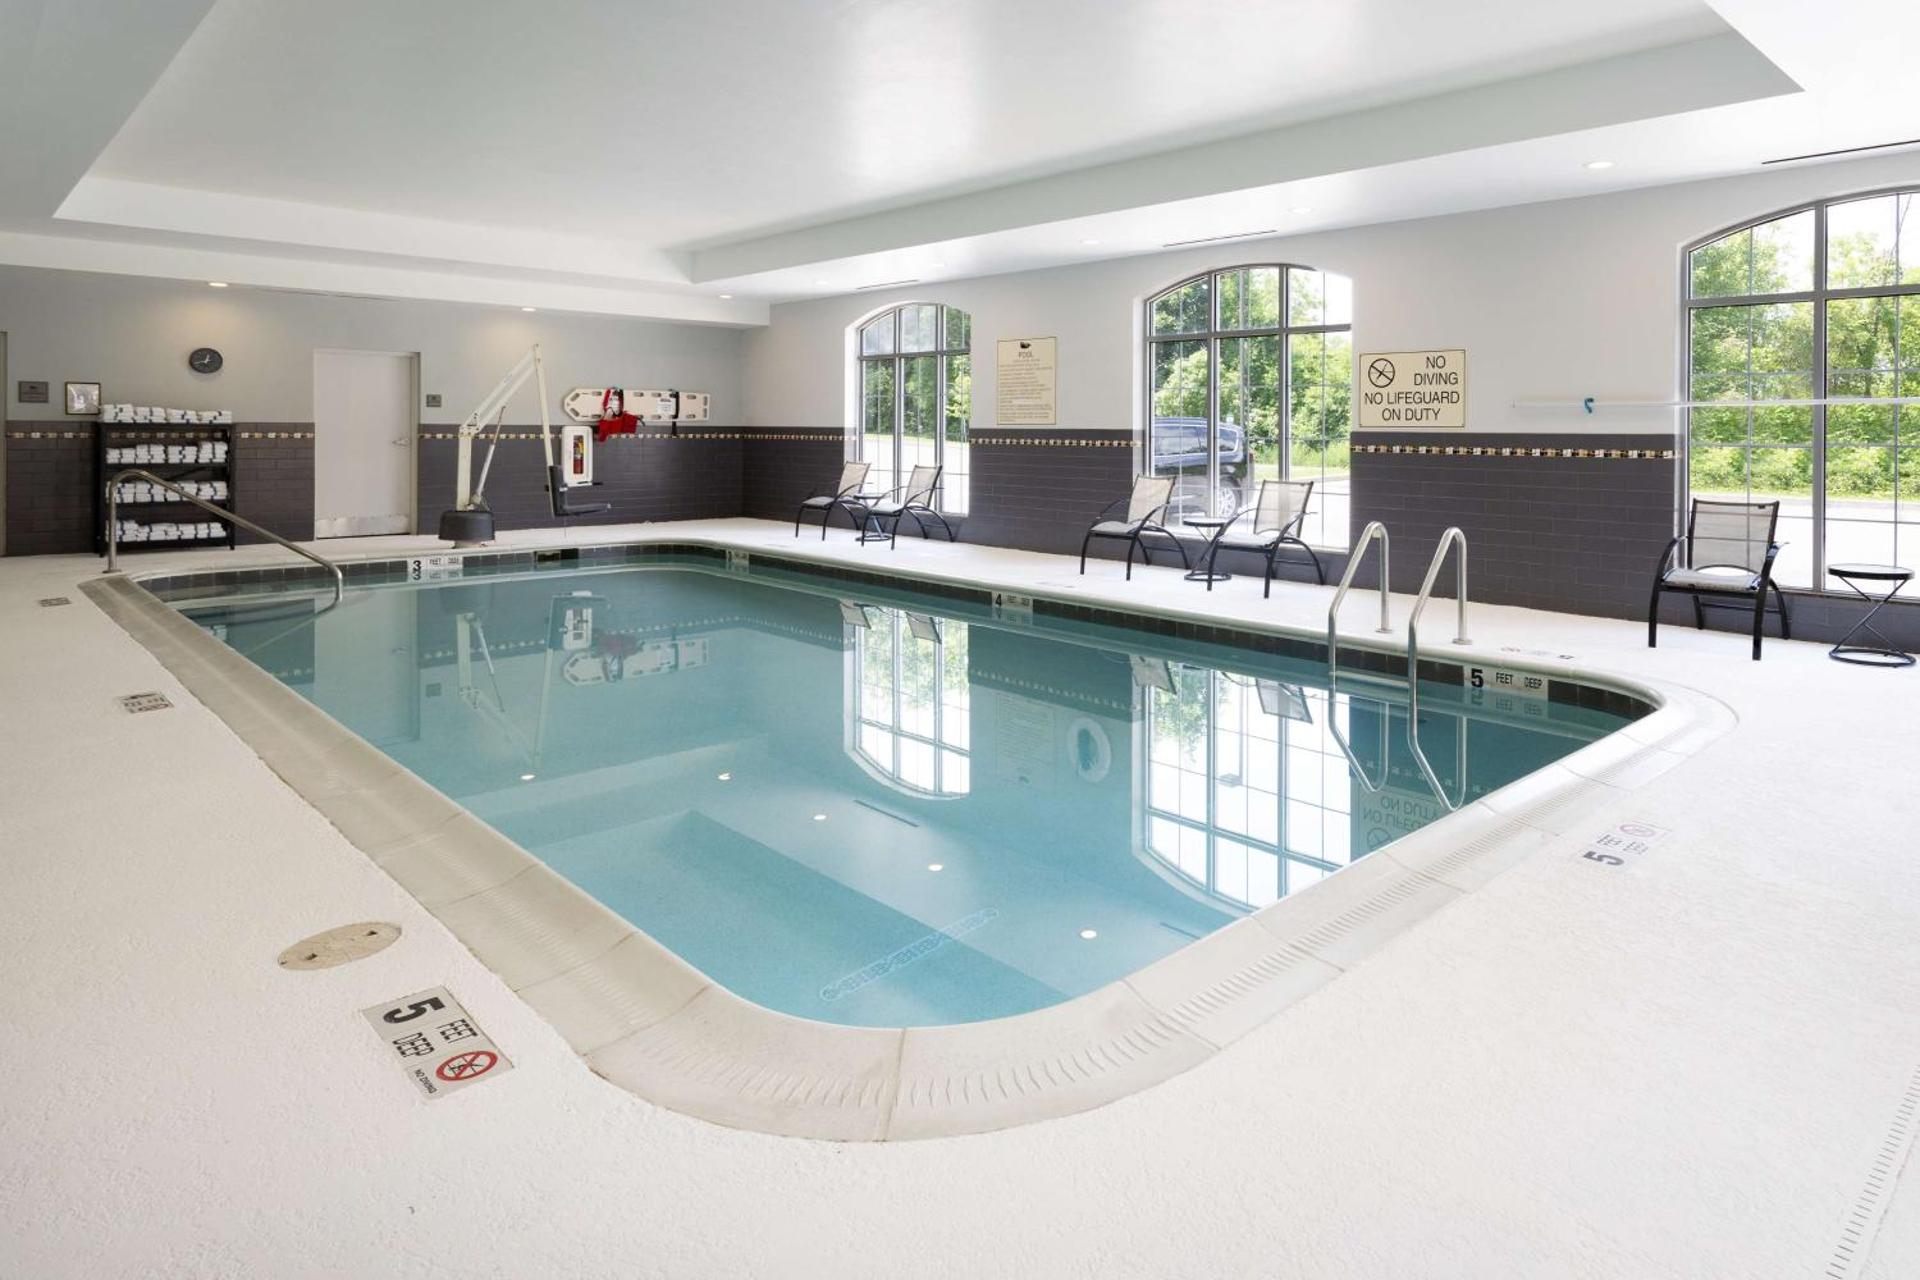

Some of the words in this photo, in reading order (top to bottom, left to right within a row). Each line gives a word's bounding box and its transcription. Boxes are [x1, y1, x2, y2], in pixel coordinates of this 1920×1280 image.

[1426, 355, 1446, 369] NO
[1414, 372, 1459, 386] DIVING
[1364, 392, 1383, 405] NO
[1387, 391, 1460, 405] LIFEGUARD
[1382, 407, 1401, 421] ON
[1405, 408, 1441, 421] DUTY
[413, 560, 421, 571] 3
[995, 593, 1002, 606] 4
[1471, 668, 1484, 688] 5
[1495, 672, 1513, 685] FEET
[1524, 676, 1543, 689] DEEP
[1582, 850, 1625, 866] 5
[383, 996, 445, 1024] 5
[435, 1018, 478, 1044] FEET
[392, 1031, 435, 1058] DEEP
